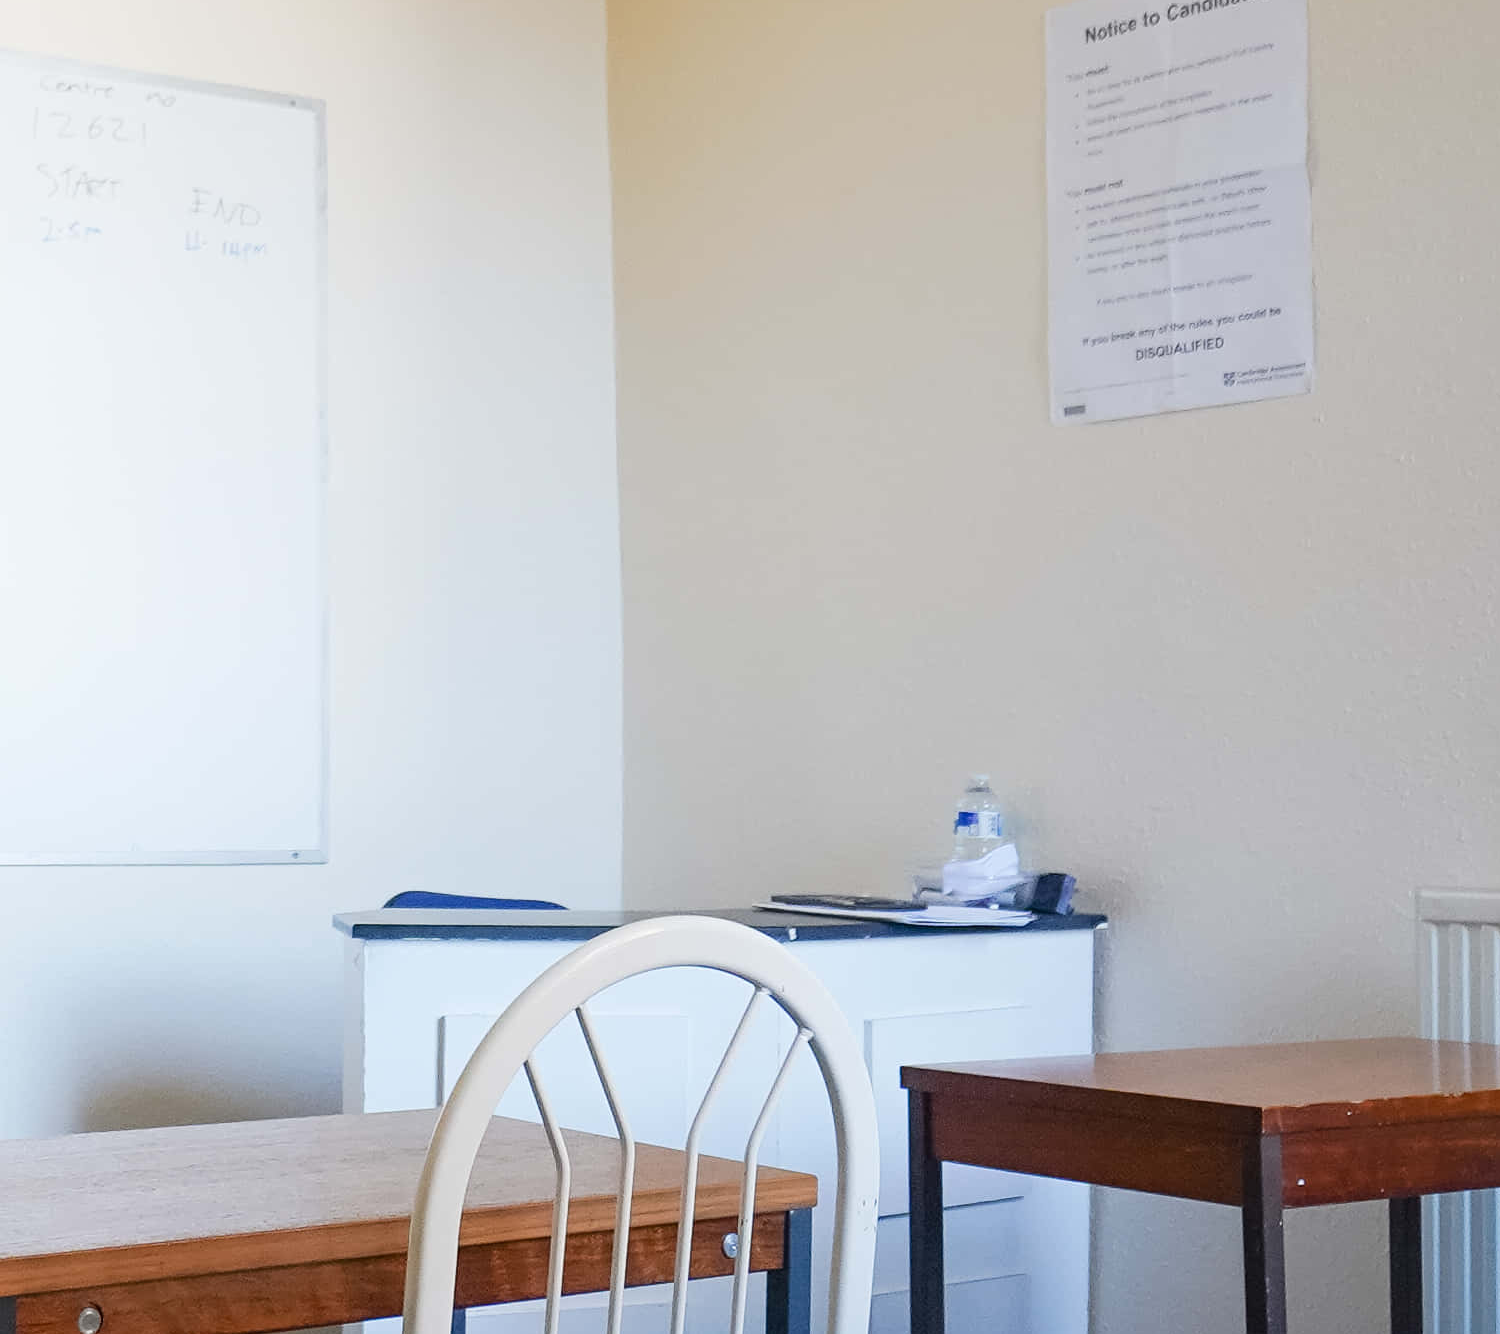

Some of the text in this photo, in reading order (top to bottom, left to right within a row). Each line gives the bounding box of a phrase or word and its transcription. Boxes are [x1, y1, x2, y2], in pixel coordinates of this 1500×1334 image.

[1085, 18, 1137, 44] Notice
[1143, 11, 1160, 28] to
[189, 187, 263, 227] END
[1216, 315, 1235, 327] you
[1135, 337, 1225, 362] DISQUALIFIED
